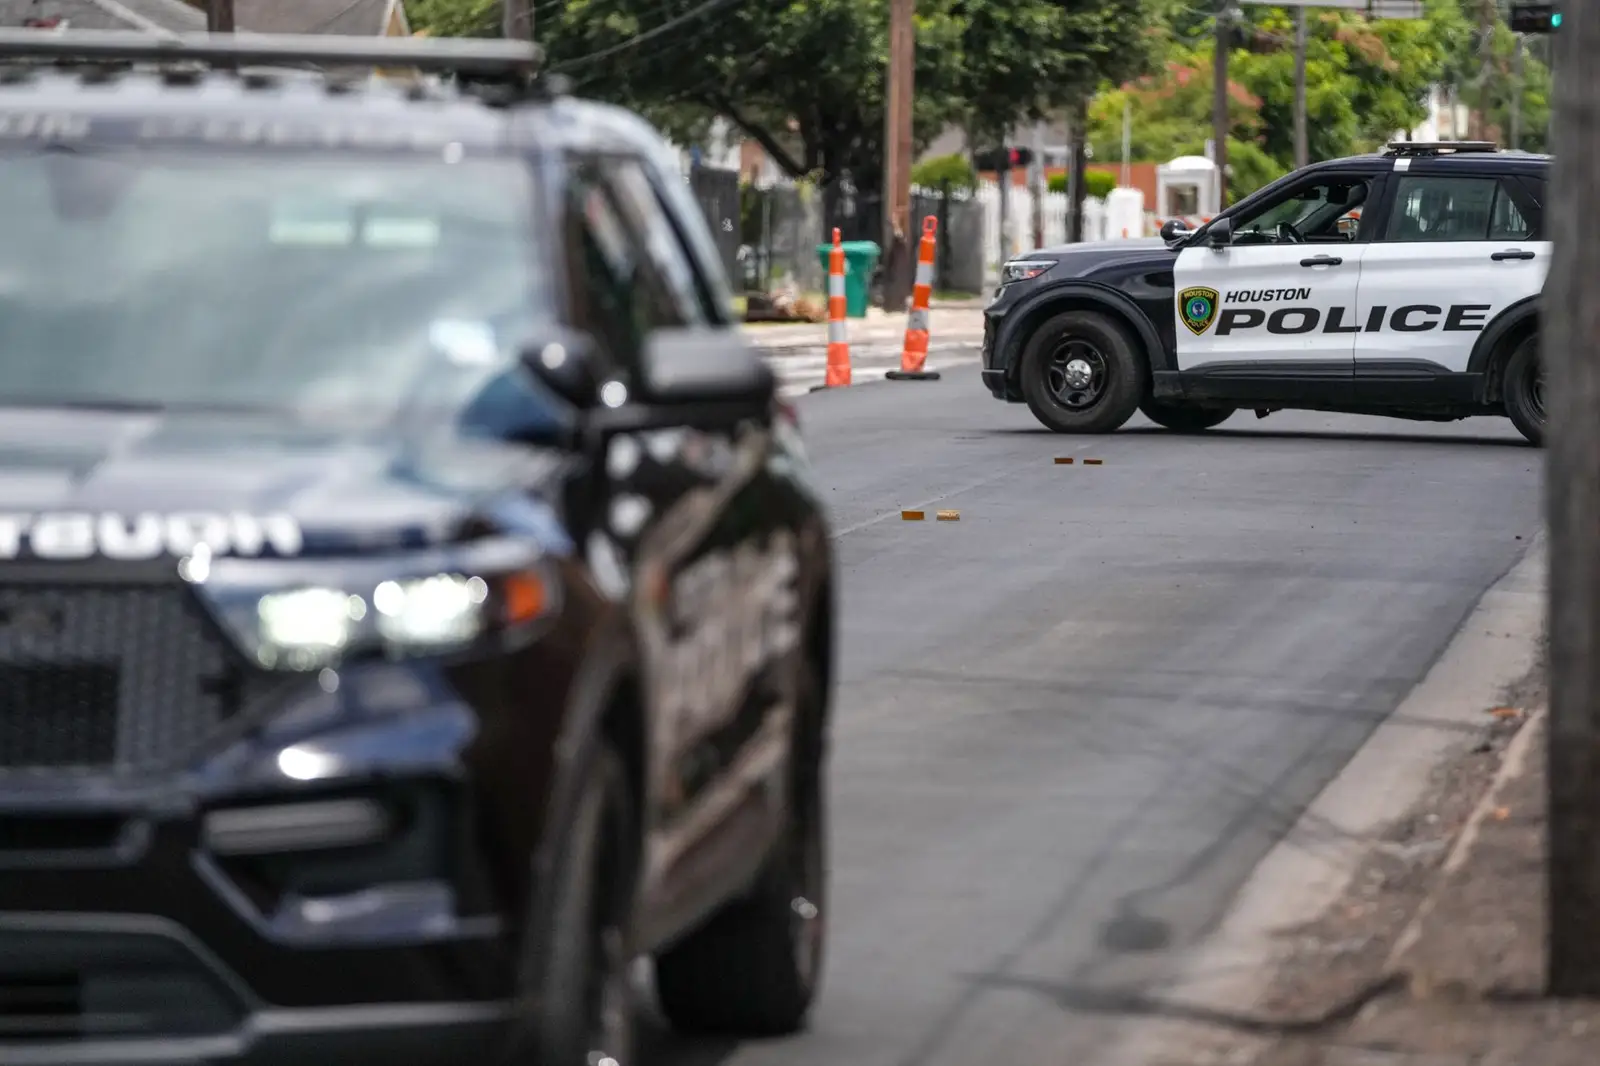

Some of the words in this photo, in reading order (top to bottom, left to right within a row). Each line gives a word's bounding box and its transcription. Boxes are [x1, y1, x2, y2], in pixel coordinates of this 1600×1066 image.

[1183, 290, 1215, 299] HOUSTON
[1225, 288, 1311, 303] HOUSTON
[1214, 304, 1491, 336] POLICE
